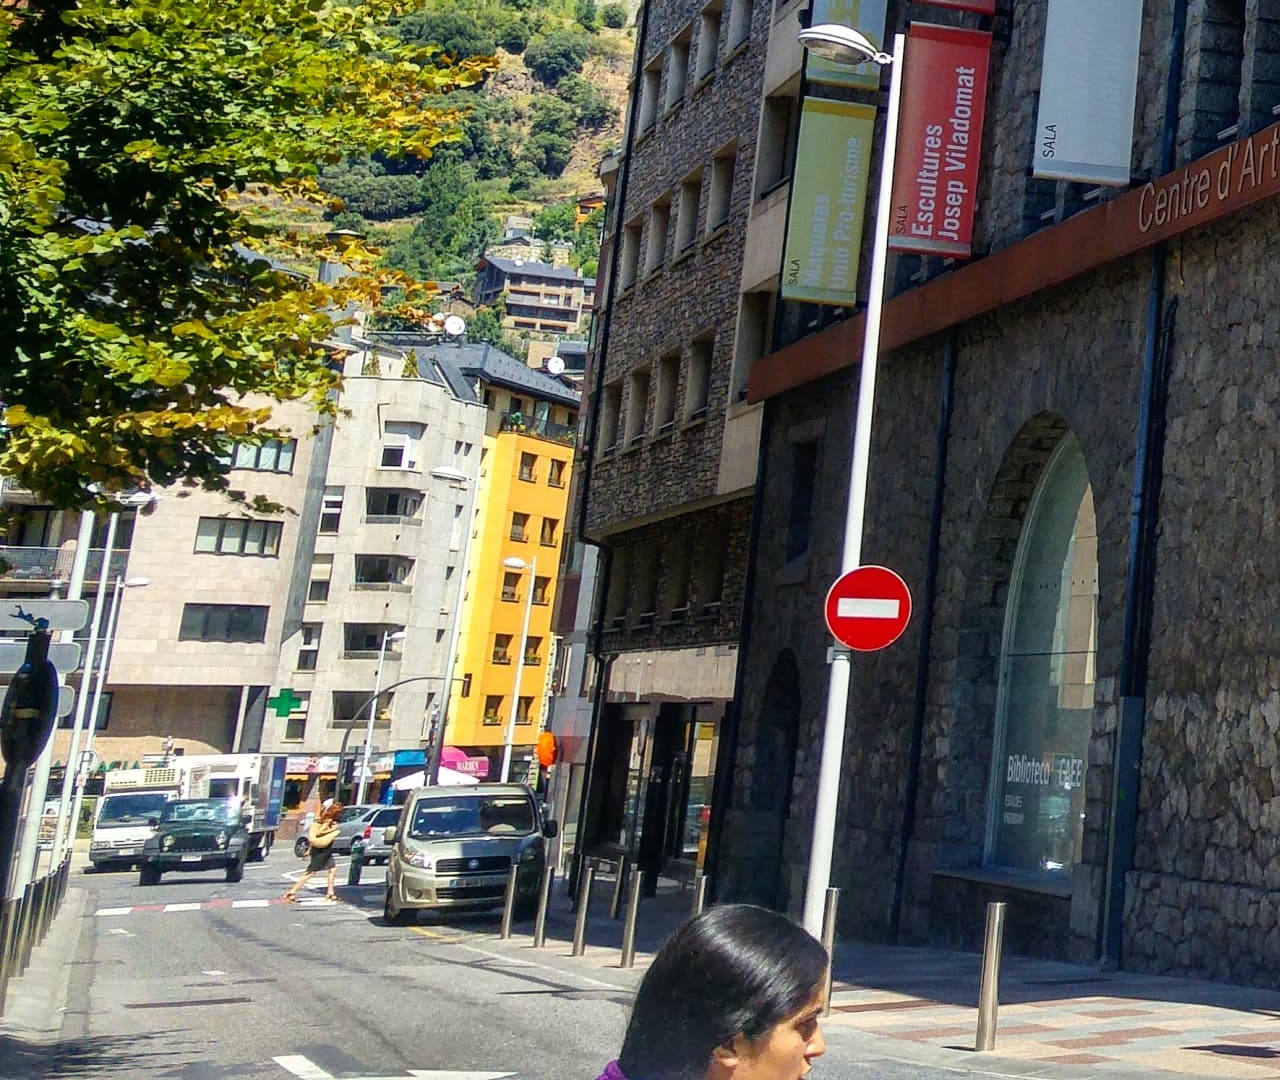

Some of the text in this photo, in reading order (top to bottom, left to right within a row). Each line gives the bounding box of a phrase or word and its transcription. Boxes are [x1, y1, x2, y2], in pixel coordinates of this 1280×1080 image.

[938, 66, 976, 241] Josep Viladomat
[1043, 124, 1057, 158] SALA
[911, 124, 943, 236] Escultures
[1138, 168, 1211, 233] Centre
[1217, 126, 1280, 201] d'Art
[803, 193, 831, 288] Maquetes
[896, 205, 908, 234] SALA
[789, 258, 800, 285] SALA
[1007, 754, 1050, 785] Biblioteca
